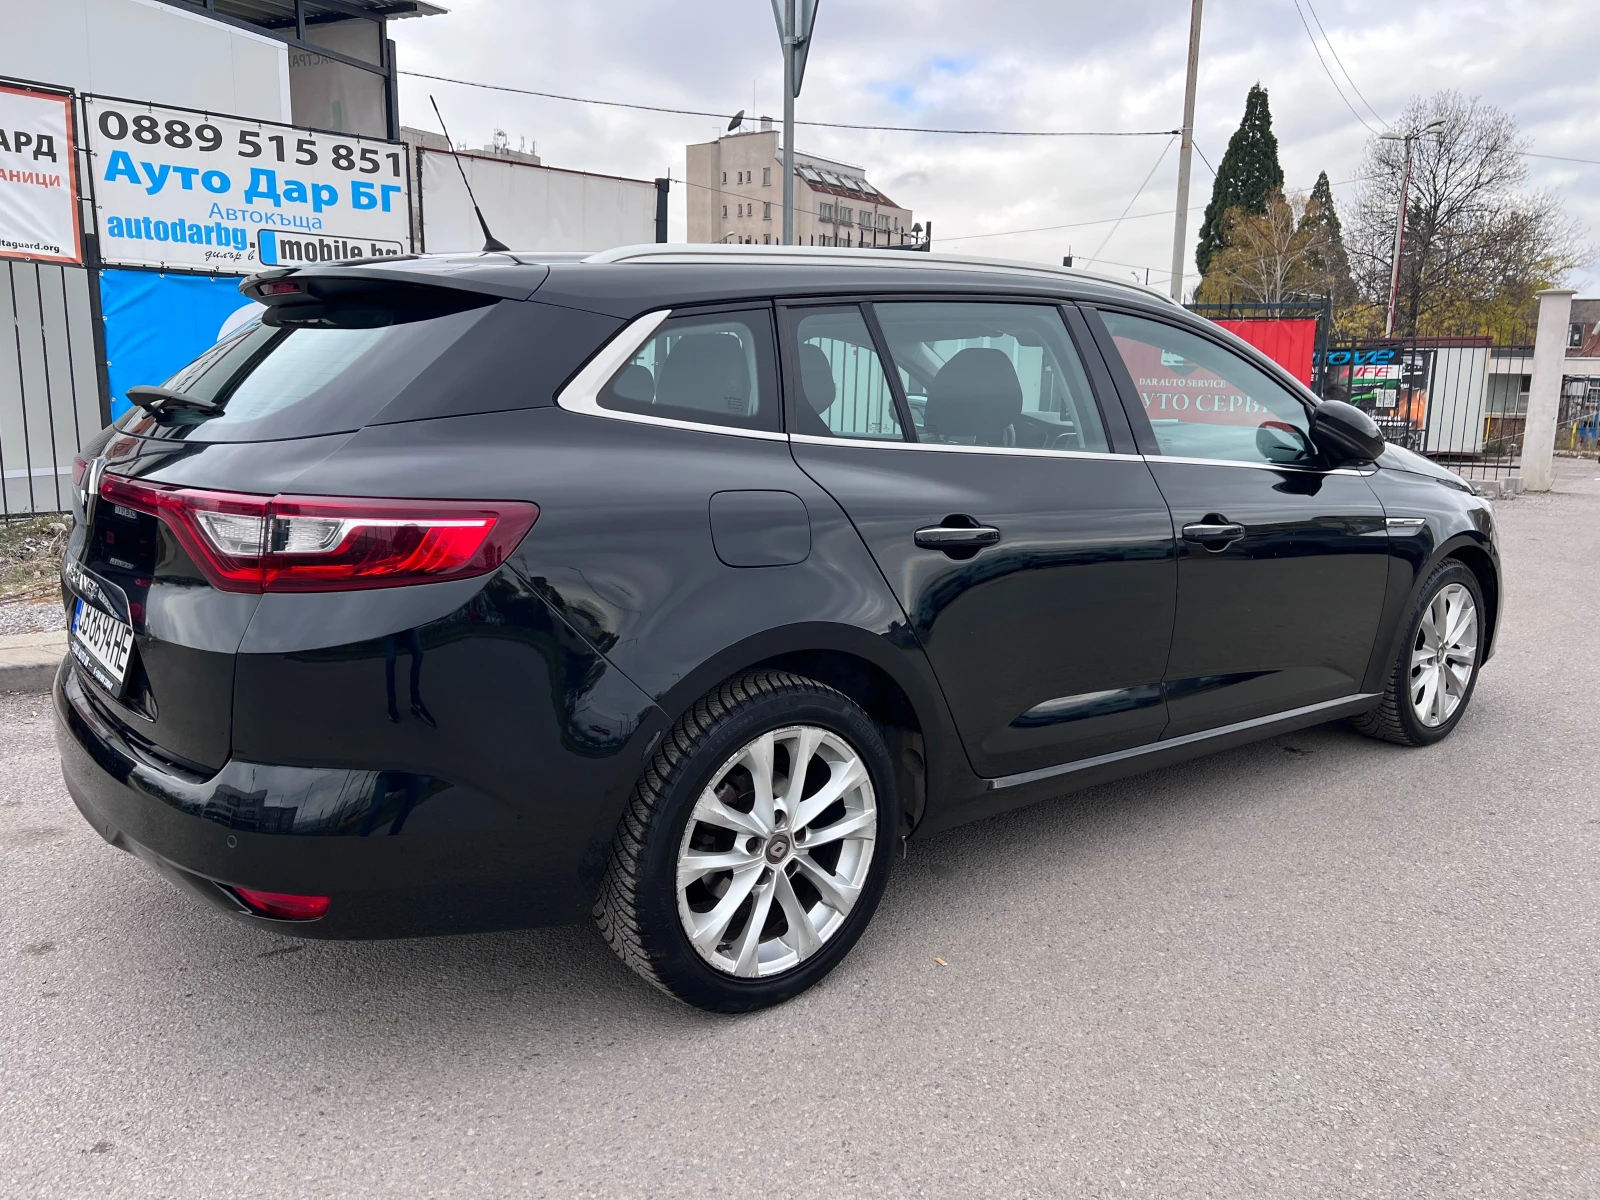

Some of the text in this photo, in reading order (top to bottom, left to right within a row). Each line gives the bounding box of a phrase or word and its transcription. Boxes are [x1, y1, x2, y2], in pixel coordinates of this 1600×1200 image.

[98, 110, 401, 178] 0889 515 851
[103, 150, 402, 213] Ауто Дар БГ
[208, 202, 322, 231] Автокъща
[1139, 377, 1227, 388] DAR AUTO SERVICE
[1195, 394, 1268, 413] СЕРВ
[853, 718, 885, 757] BERLIN
